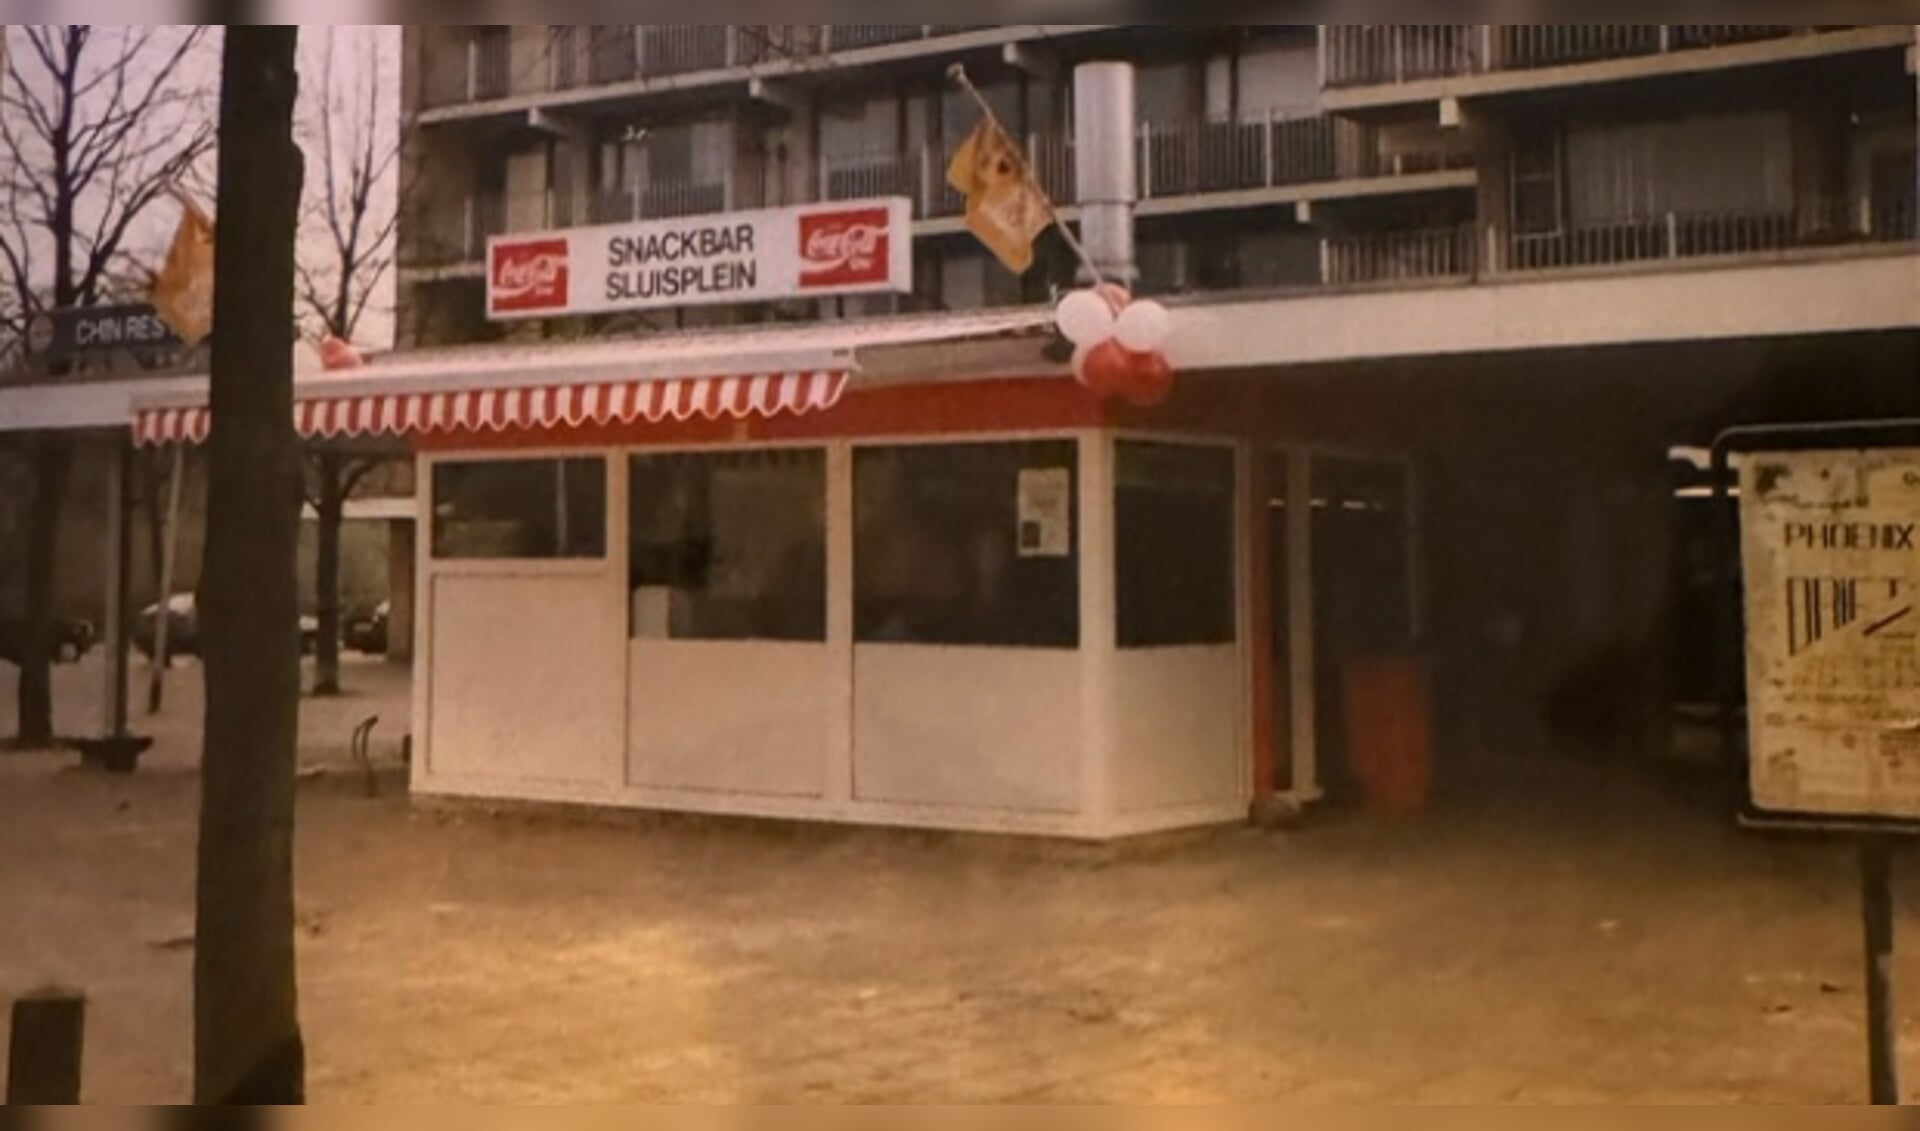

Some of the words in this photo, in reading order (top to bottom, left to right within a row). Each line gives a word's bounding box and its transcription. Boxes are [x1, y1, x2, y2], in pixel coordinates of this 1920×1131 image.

[608, 223, 754, 266] SNACKBAR
[606, 259, 756, 299] SLUISPLEIN
[76, 319, 122, 345] CHIN
[1784, 521, 1915, 549] PHOENIX
